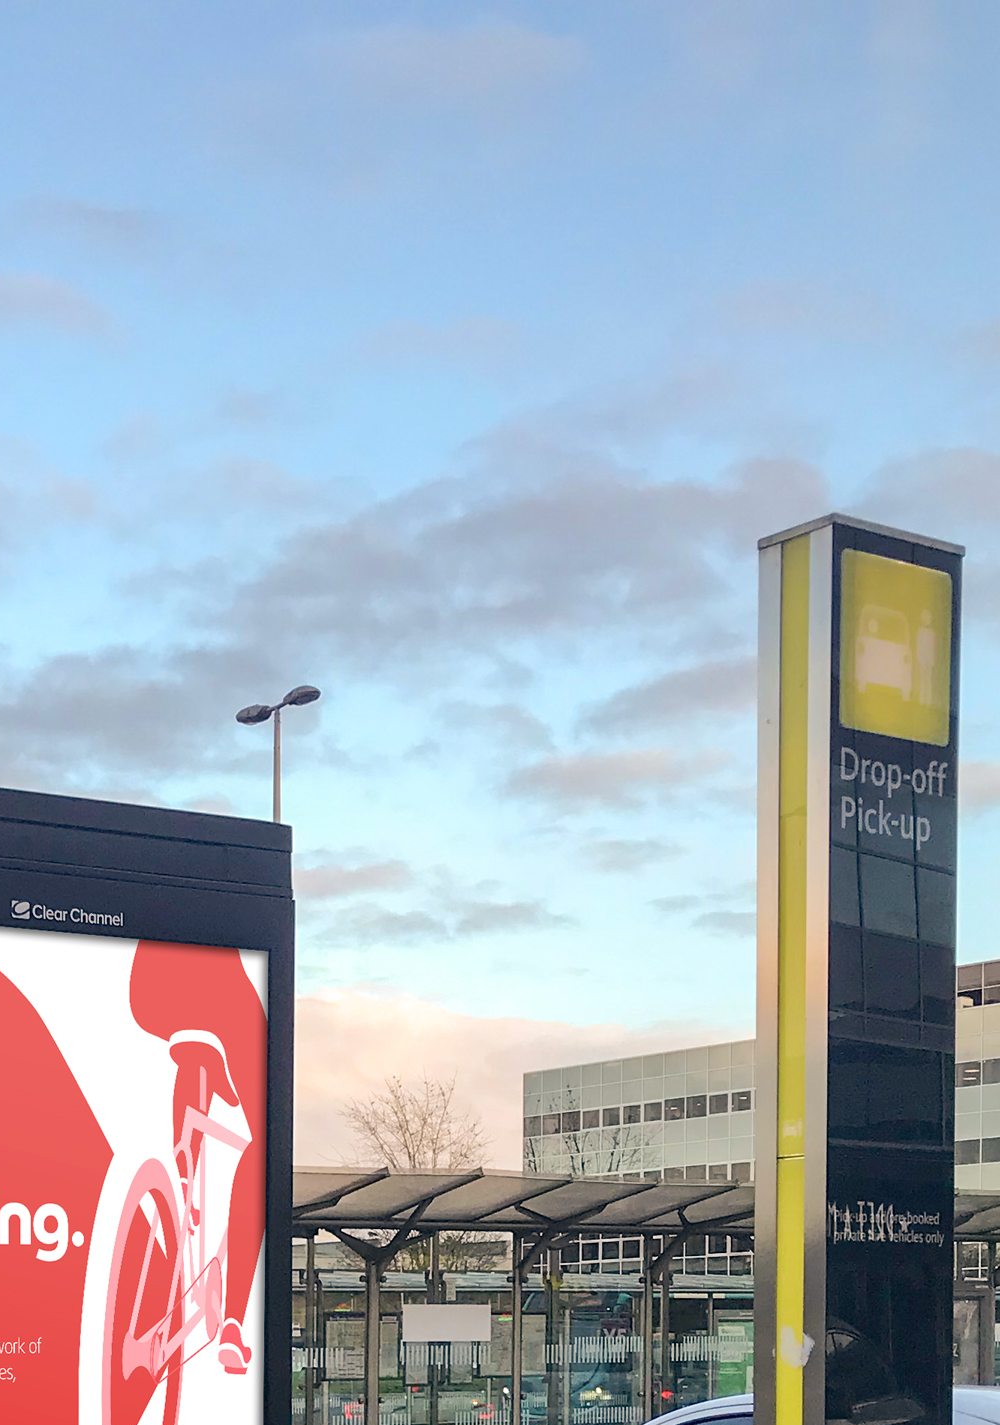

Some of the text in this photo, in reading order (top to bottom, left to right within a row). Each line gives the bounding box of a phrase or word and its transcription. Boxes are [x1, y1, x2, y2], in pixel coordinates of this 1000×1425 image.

[841, 746, 948, 798] Drop-off
[841, 796, 931, 851] Pick-up
[32, 904, 124, 927] Clear Channel
[925, 1230, 945, 1247] only
[28, 1336, 42, 1354] of
